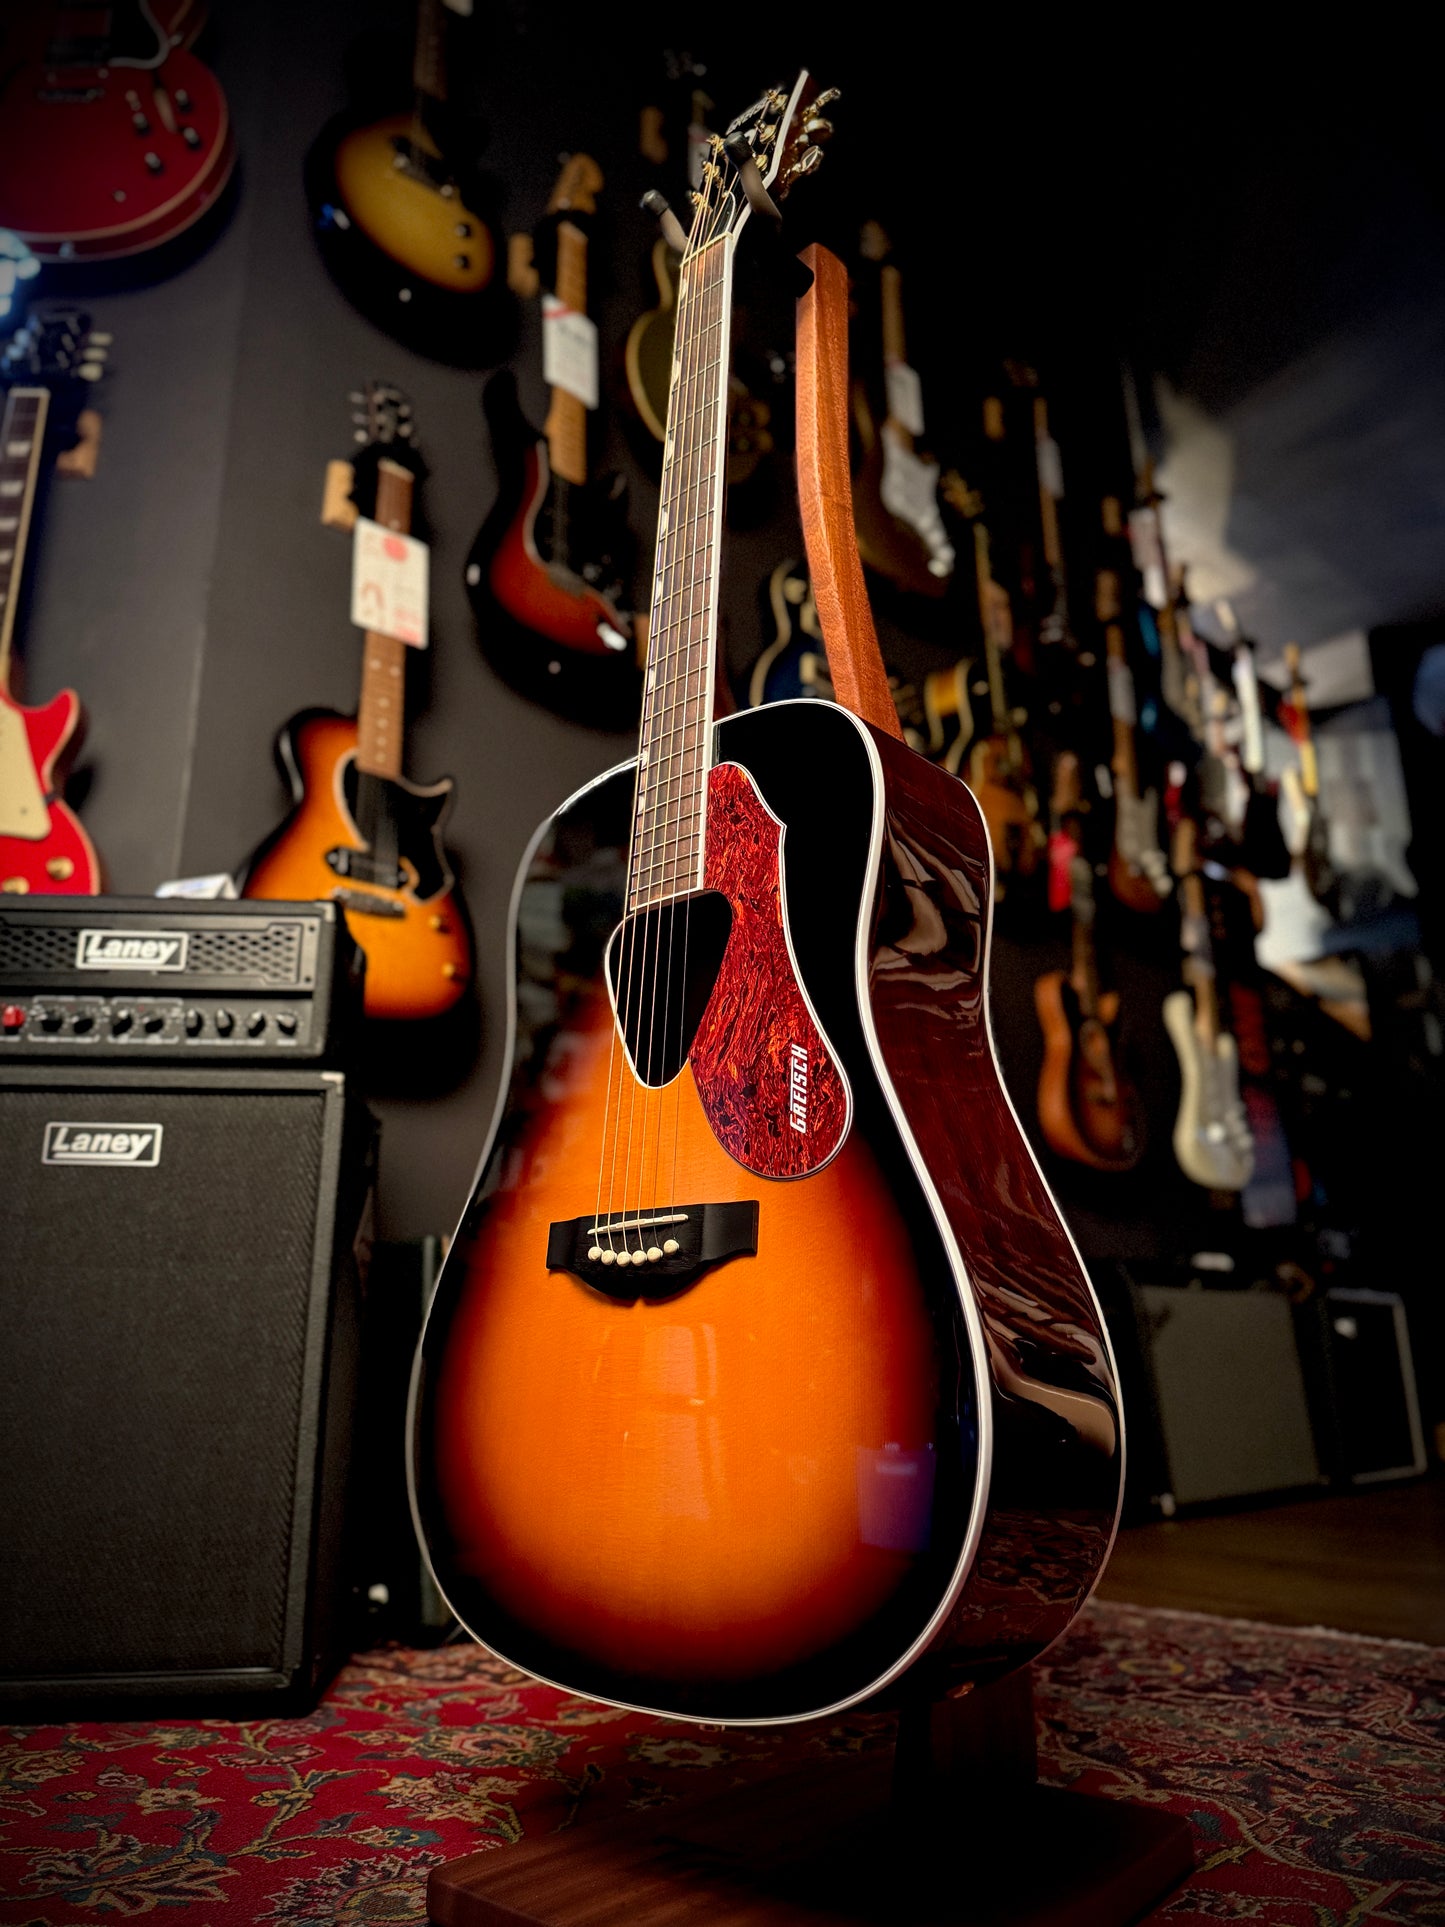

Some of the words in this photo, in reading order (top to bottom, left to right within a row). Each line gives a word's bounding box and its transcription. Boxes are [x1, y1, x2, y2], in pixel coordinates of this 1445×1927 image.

[86, 935, 179, 964] Laney
[789, 1043, 808, 1134] GRETSCH
[51, 1127, 153, 1160] Laney
